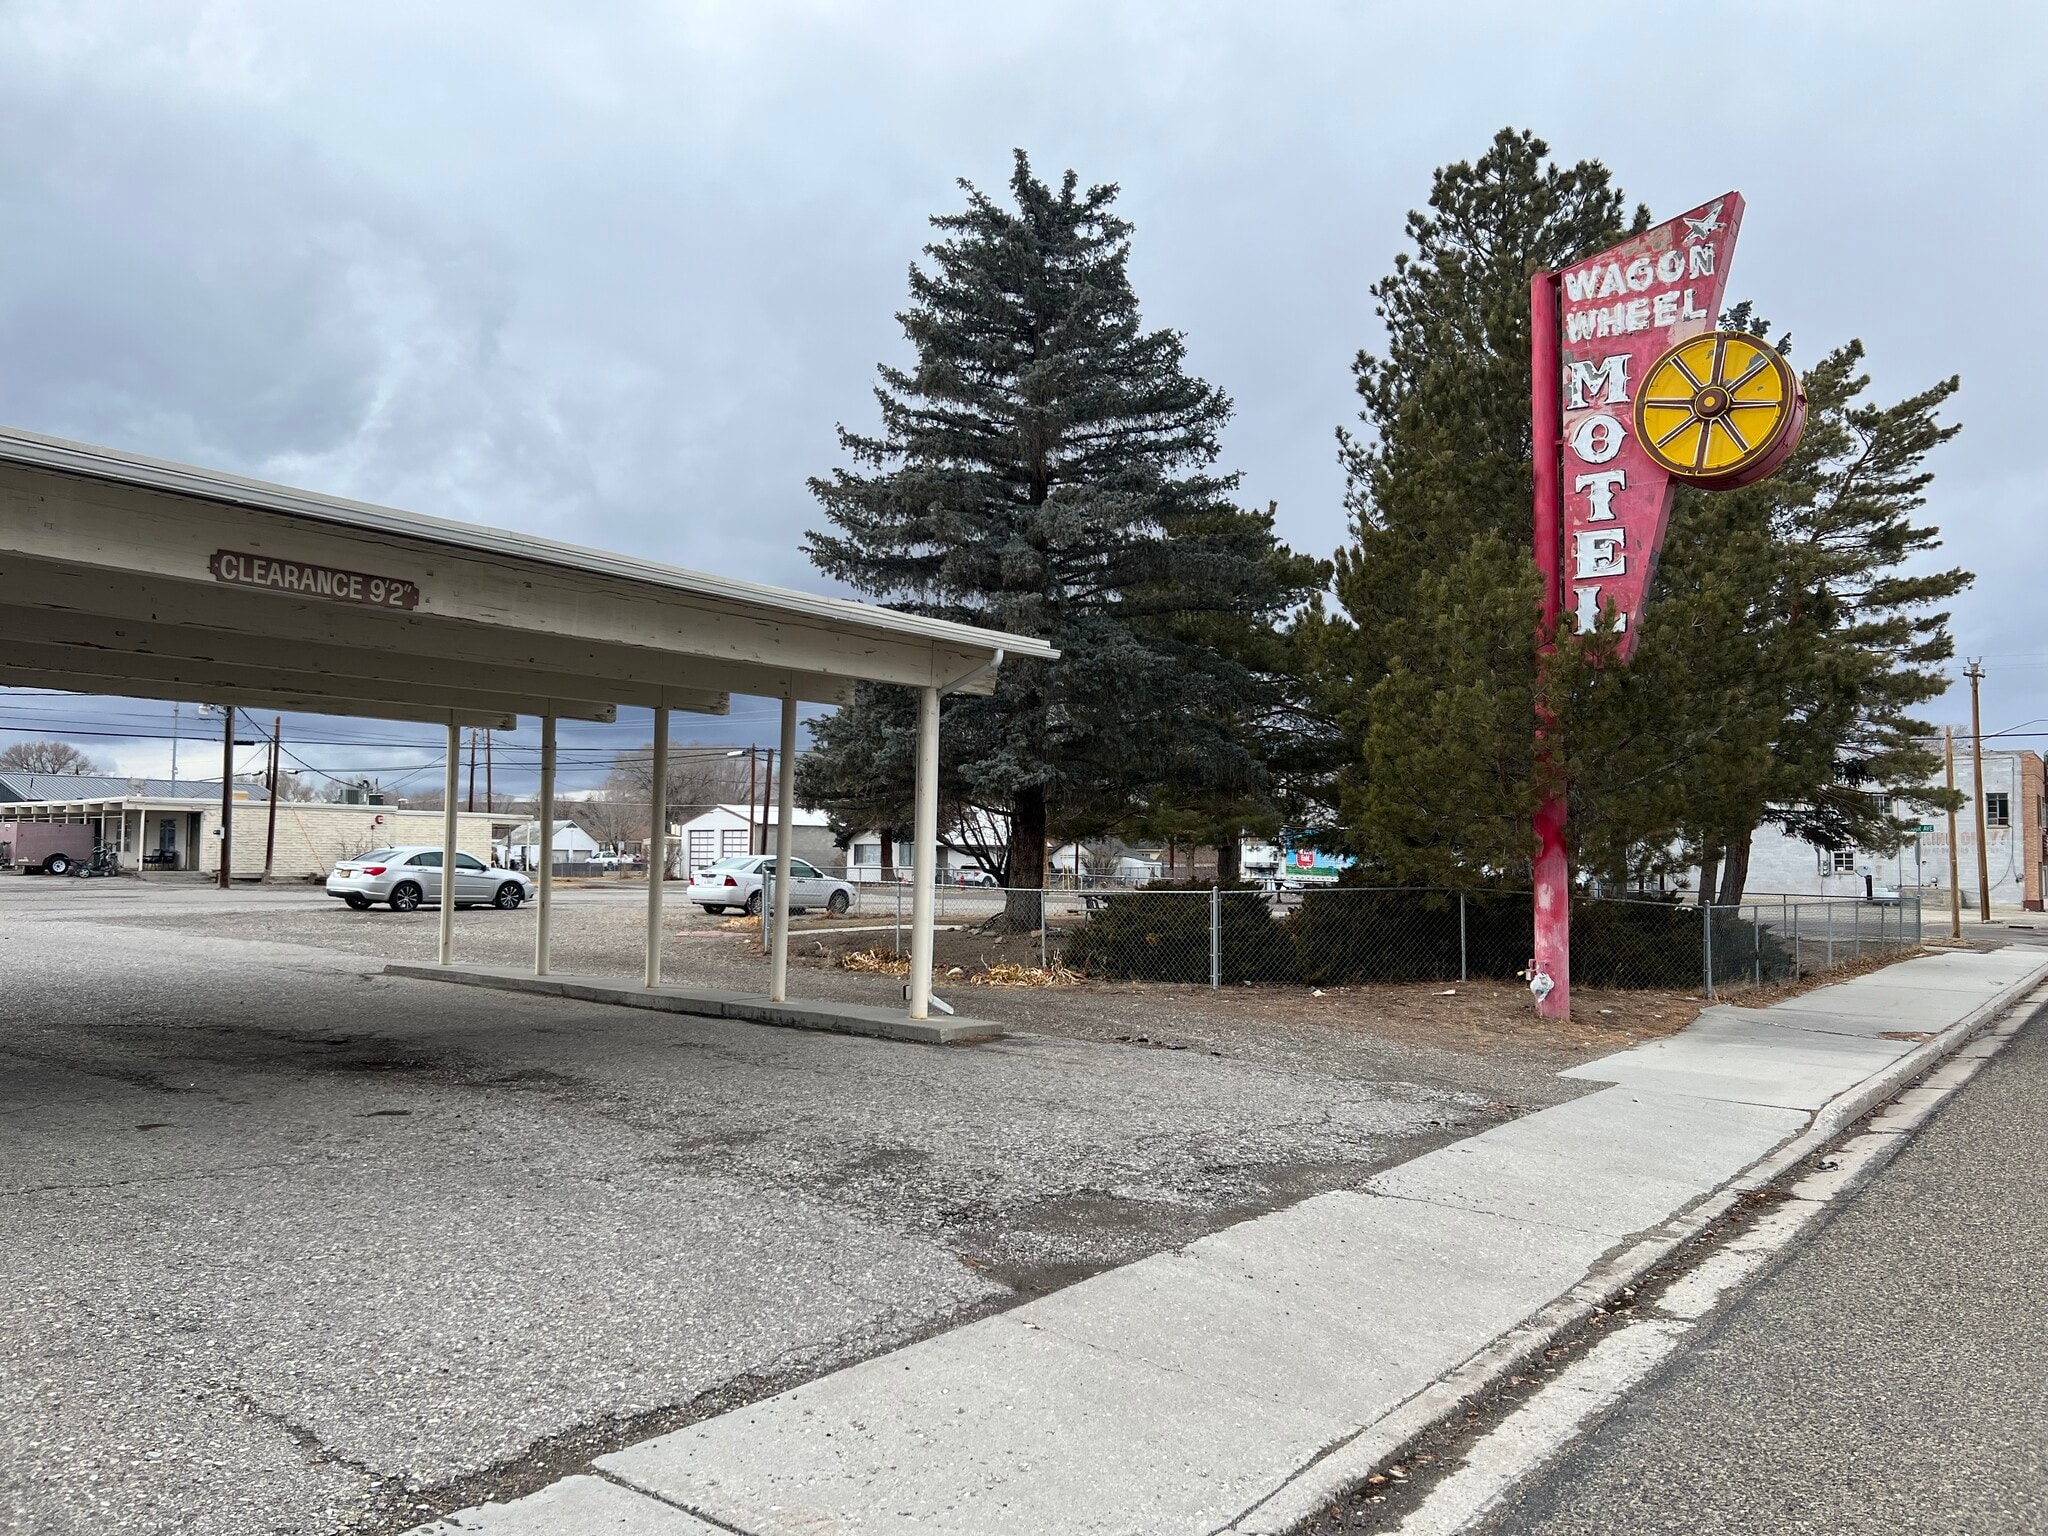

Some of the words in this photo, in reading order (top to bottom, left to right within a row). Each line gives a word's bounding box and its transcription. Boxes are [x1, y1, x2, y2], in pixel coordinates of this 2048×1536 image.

[1565, 243, 1716, 302] WAGON
[1566, 288, 1708, 344] WHEEL
[1567, 353, 1632, 636] MOTEL
[219, 554, 363, 600] CLEARANCE
[369, 579, 412, 606] 9'2"
[1922, 824, 1934, 832] AVE
